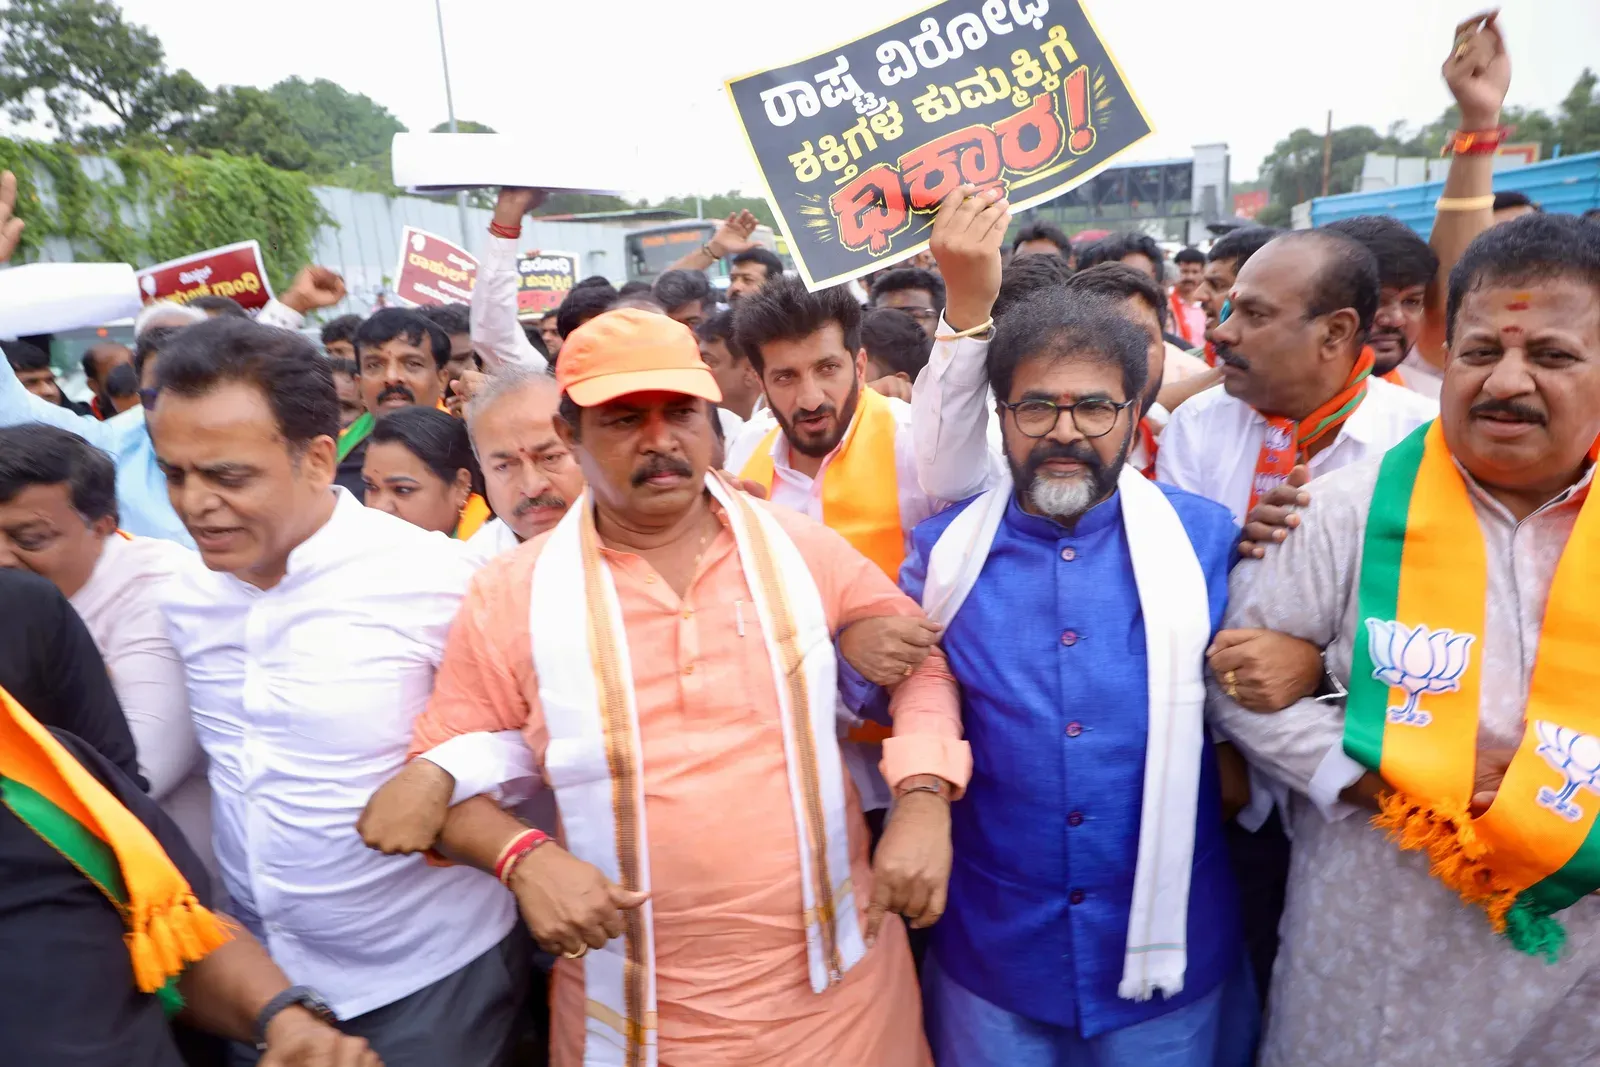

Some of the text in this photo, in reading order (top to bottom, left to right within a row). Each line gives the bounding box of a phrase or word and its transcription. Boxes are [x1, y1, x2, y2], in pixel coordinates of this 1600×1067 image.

[760, 55, 888, 127] ರಾಷ್ಟ್ರ
[788, 25, 1079, 185] ಶಕ್ತಿಗಳ ಕುಮ್ಮಕ್ಕಿಗೆ
